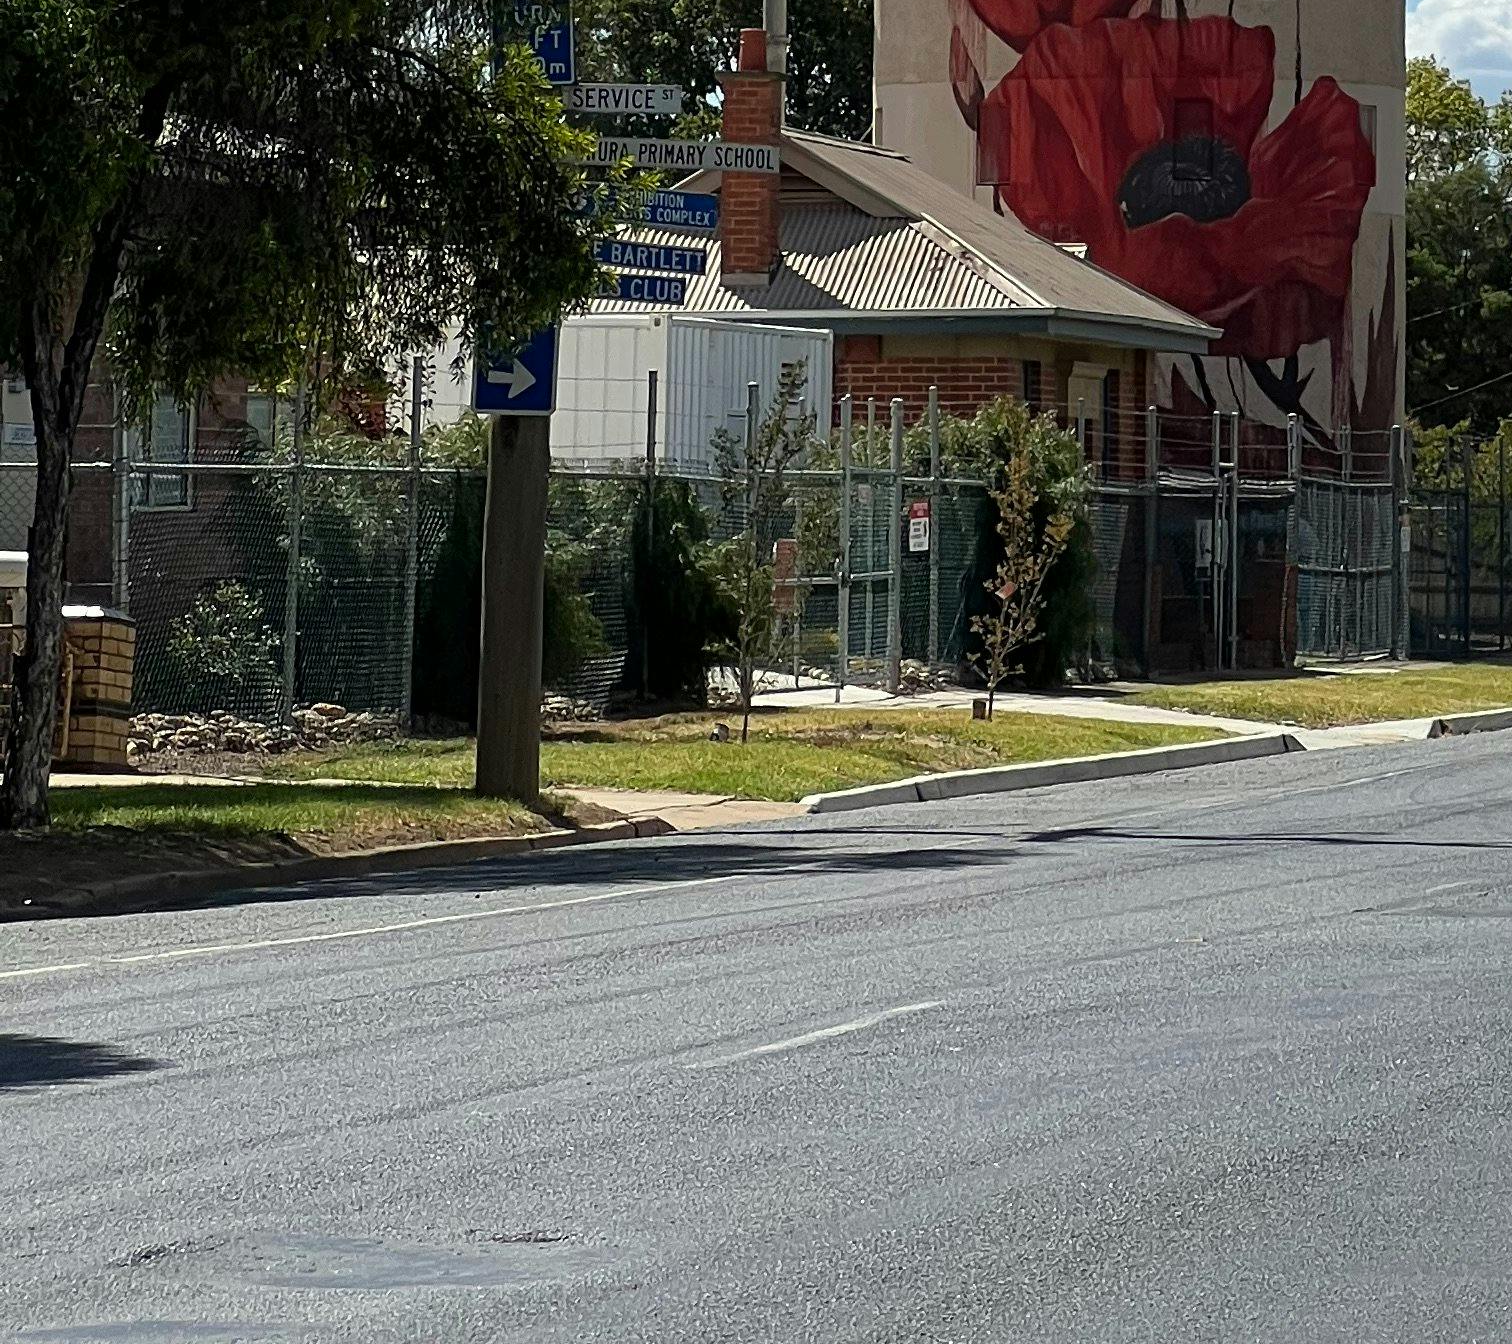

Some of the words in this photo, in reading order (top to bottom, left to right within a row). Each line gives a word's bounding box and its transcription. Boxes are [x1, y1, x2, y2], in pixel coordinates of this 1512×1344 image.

[572, 88, 656, 110] SERVICE
[661, 89, 674, 100] ST
[586, 141, 629, 163] URA
[638, 143, 706, 167] PRIMARY
[713, 147, 774, 170] SCHOOL
[656, 207, 710, 226] COMPLEX
[611, 243, 704, 272] BARTLETT
[630, 278, 683, 302] CLUB
